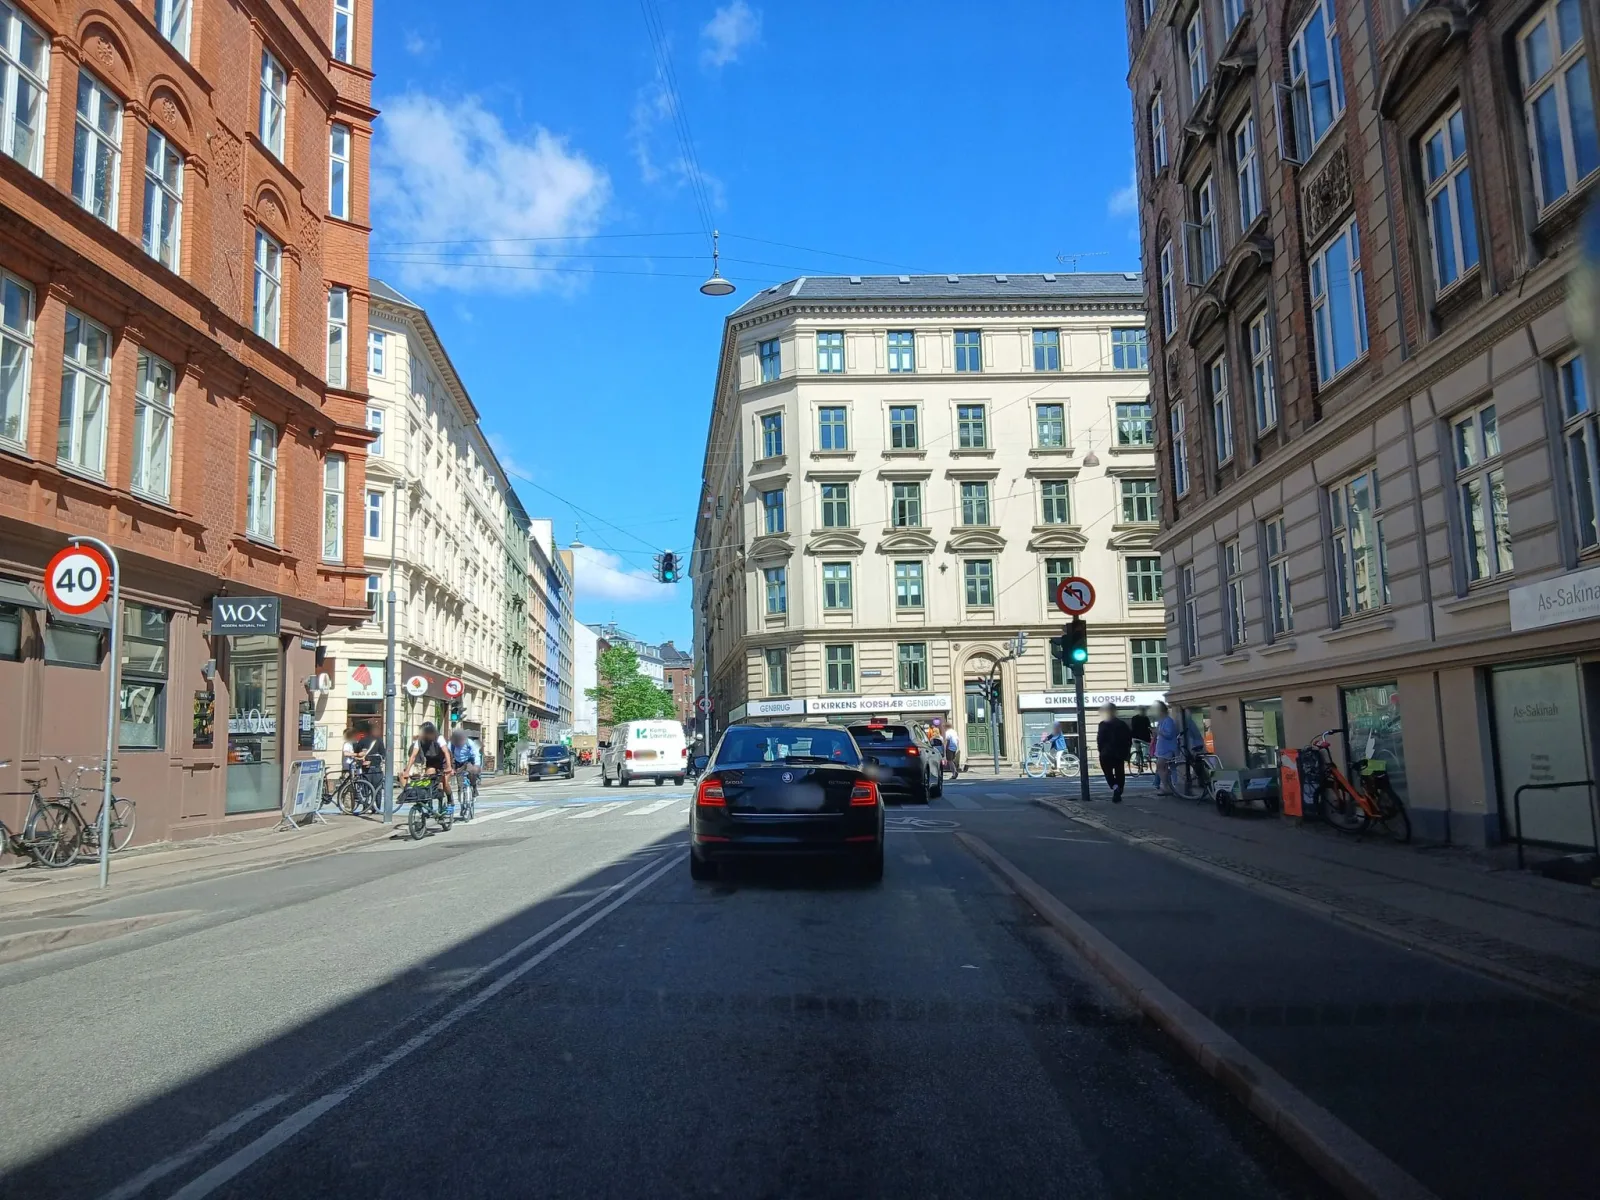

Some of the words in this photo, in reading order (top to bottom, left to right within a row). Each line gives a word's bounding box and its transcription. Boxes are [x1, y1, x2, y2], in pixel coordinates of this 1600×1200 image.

[56, 567, 97, 593] 40
[218, 604, 268, 622] WOK
[821, 701, 857, 710] KIRKENS
[859, 700, 903, 709] KORSHÆR
[906, 699, 946, 708] GENBRUG
[1053, 696, 1090, 704] KIRKES
[1092, 695, 1136, 704] KORSHÆR
[759, 703, 790, 713] GENBRUG
